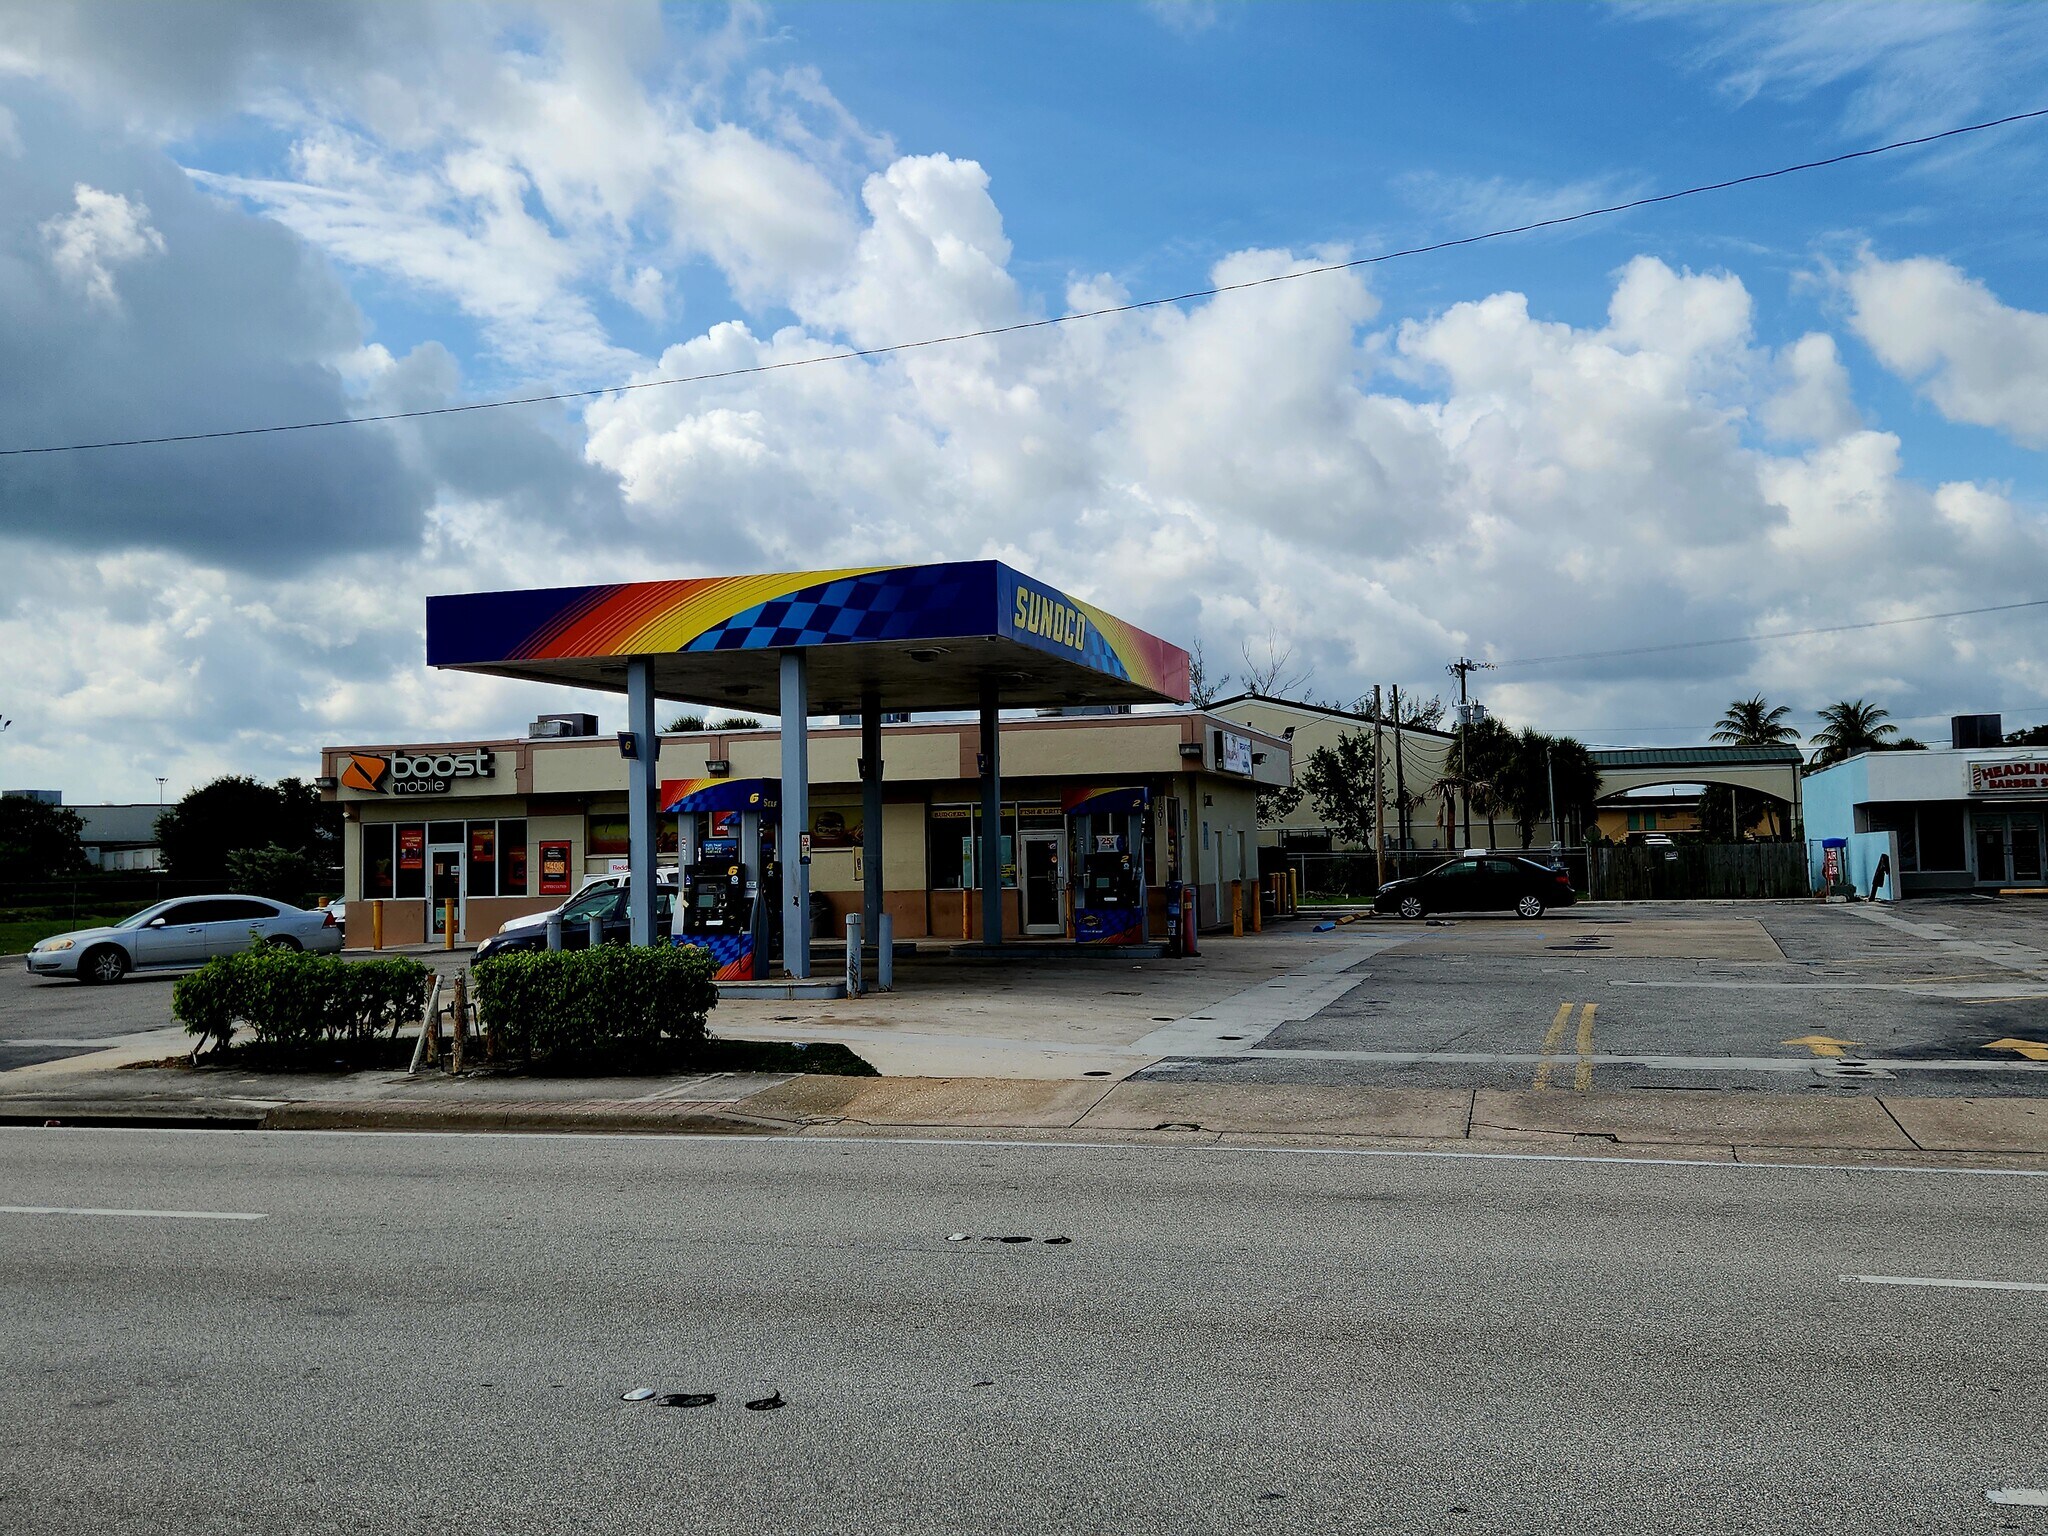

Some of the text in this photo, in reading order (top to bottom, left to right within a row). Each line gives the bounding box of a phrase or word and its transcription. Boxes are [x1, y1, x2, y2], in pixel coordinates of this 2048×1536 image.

[1014, 585, 1086, 651] SUNOCO
[624, 740, 632, 751] 6
[391, 748, 488, 778] boost
[393, 778, 445, 792] mobile
[1988, 778, 2037, 788] BARBER
[749, 793, 759, 804] 6
[1132, 799, 1141, 808] 2
[1120, 855, 1130, 863] 2
[727, 865, 739, 876] 6
